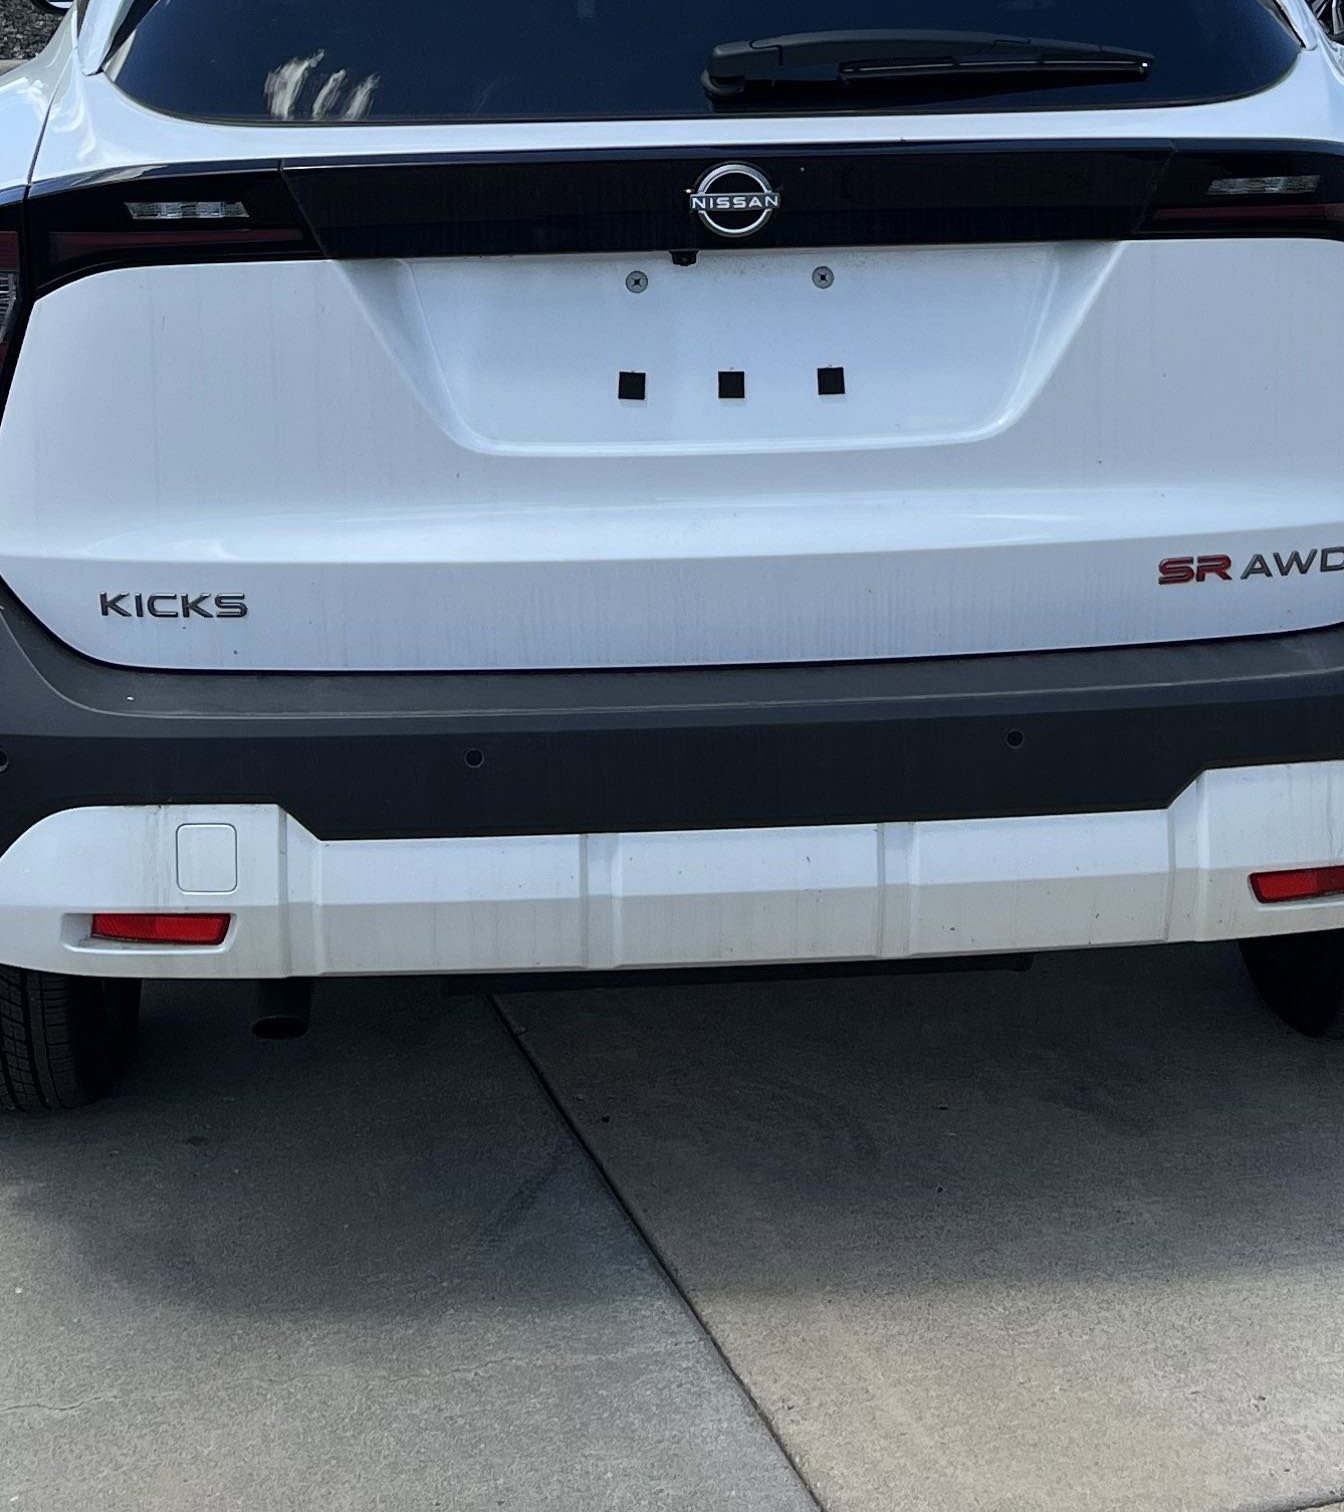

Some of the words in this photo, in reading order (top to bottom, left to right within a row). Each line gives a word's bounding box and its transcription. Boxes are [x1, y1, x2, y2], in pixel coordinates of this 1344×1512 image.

[691, 195, 778, 209] NISSAN
[1158, 554, 1232, 585] SR
[99, 592, 248, 618] KICKS
